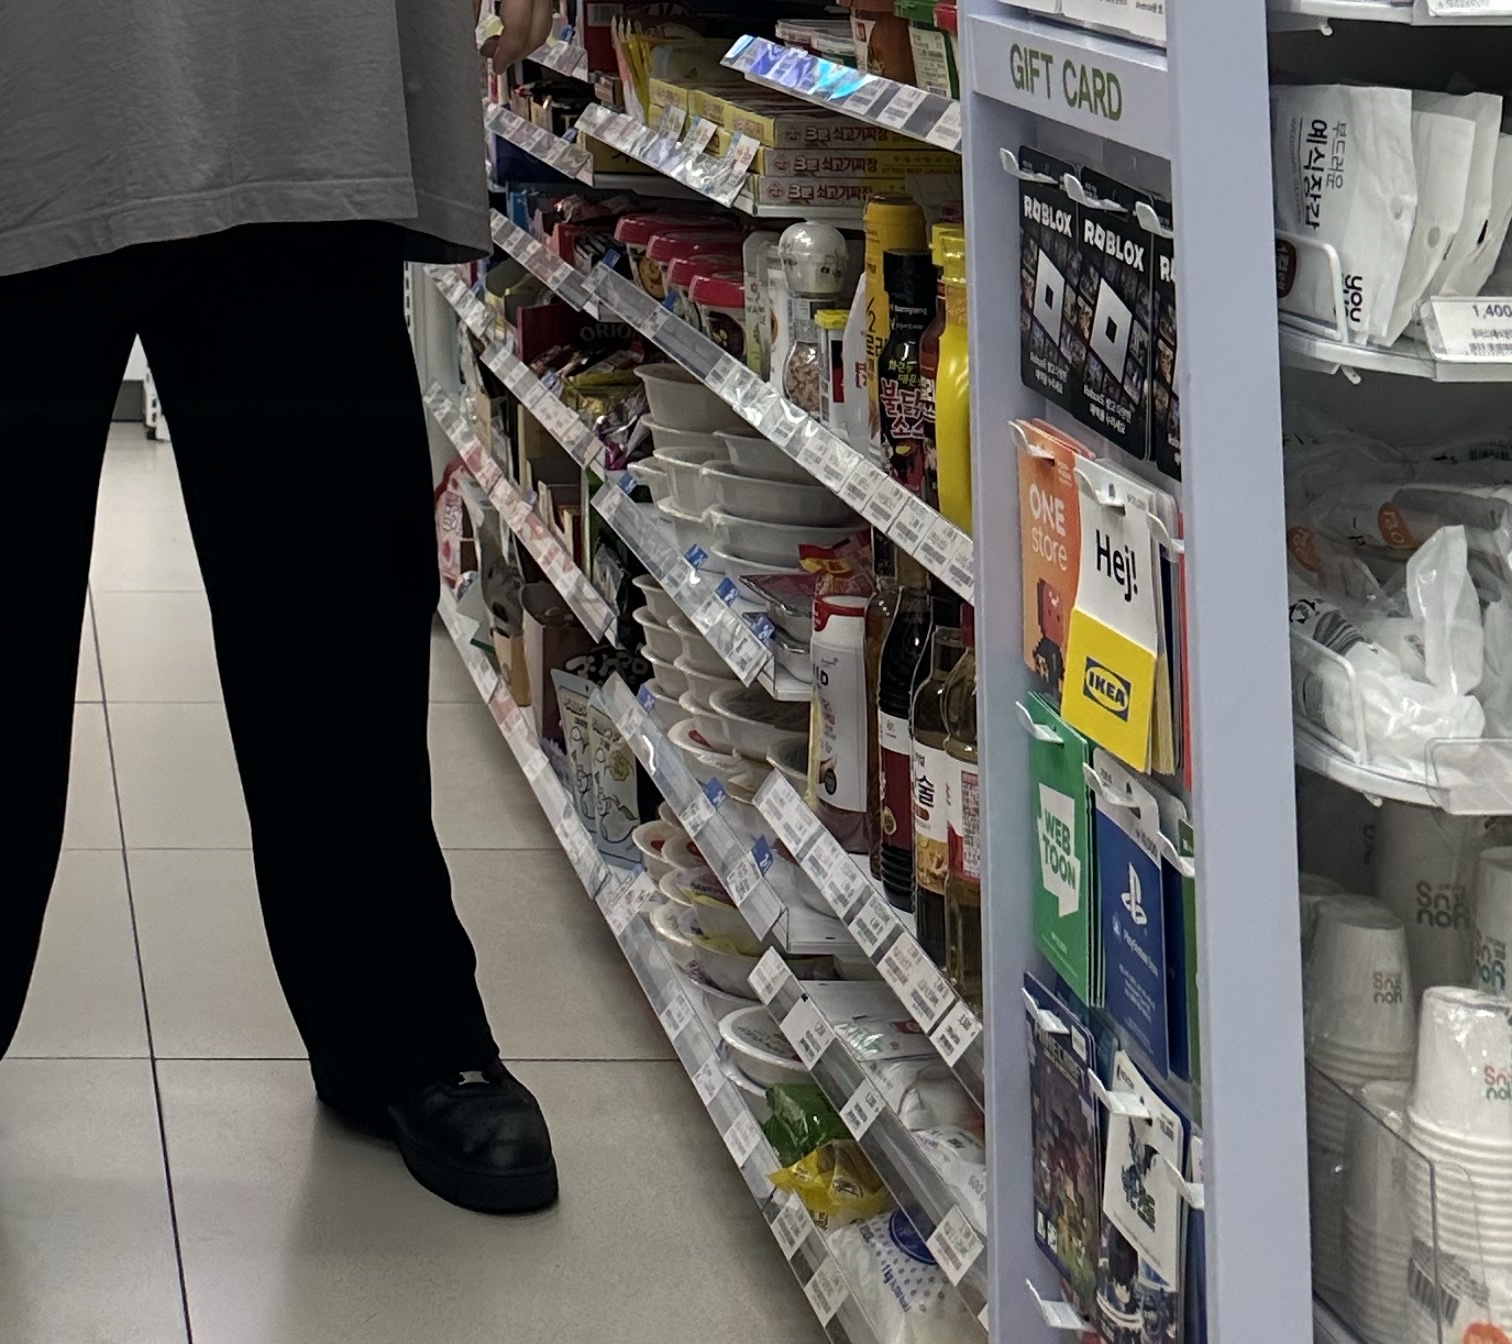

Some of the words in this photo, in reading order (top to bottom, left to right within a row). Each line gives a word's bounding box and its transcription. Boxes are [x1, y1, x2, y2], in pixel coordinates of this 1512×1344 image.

[1009, 42, 1054, 100] GIFT
[1062, 58, 1123, 122] CARD
[1302, 118, 1329, 230] 예식장갑
[1325, 120, 1349, 190] 부드러운
[1023, 194, 1073, 239] ROBLOX
[1083, 218, 1145, 273] ROBLOX
[1028, 482, 1066, 537] ONE
[1031, 526, 1068, 572] store
[1095, 528, 1138, 603] Hej!
[1088, 669, 1127, 708] IKEA
[1043, 807, 1071, 856] WEB
[1041, 833, 1077, 891] TOON
